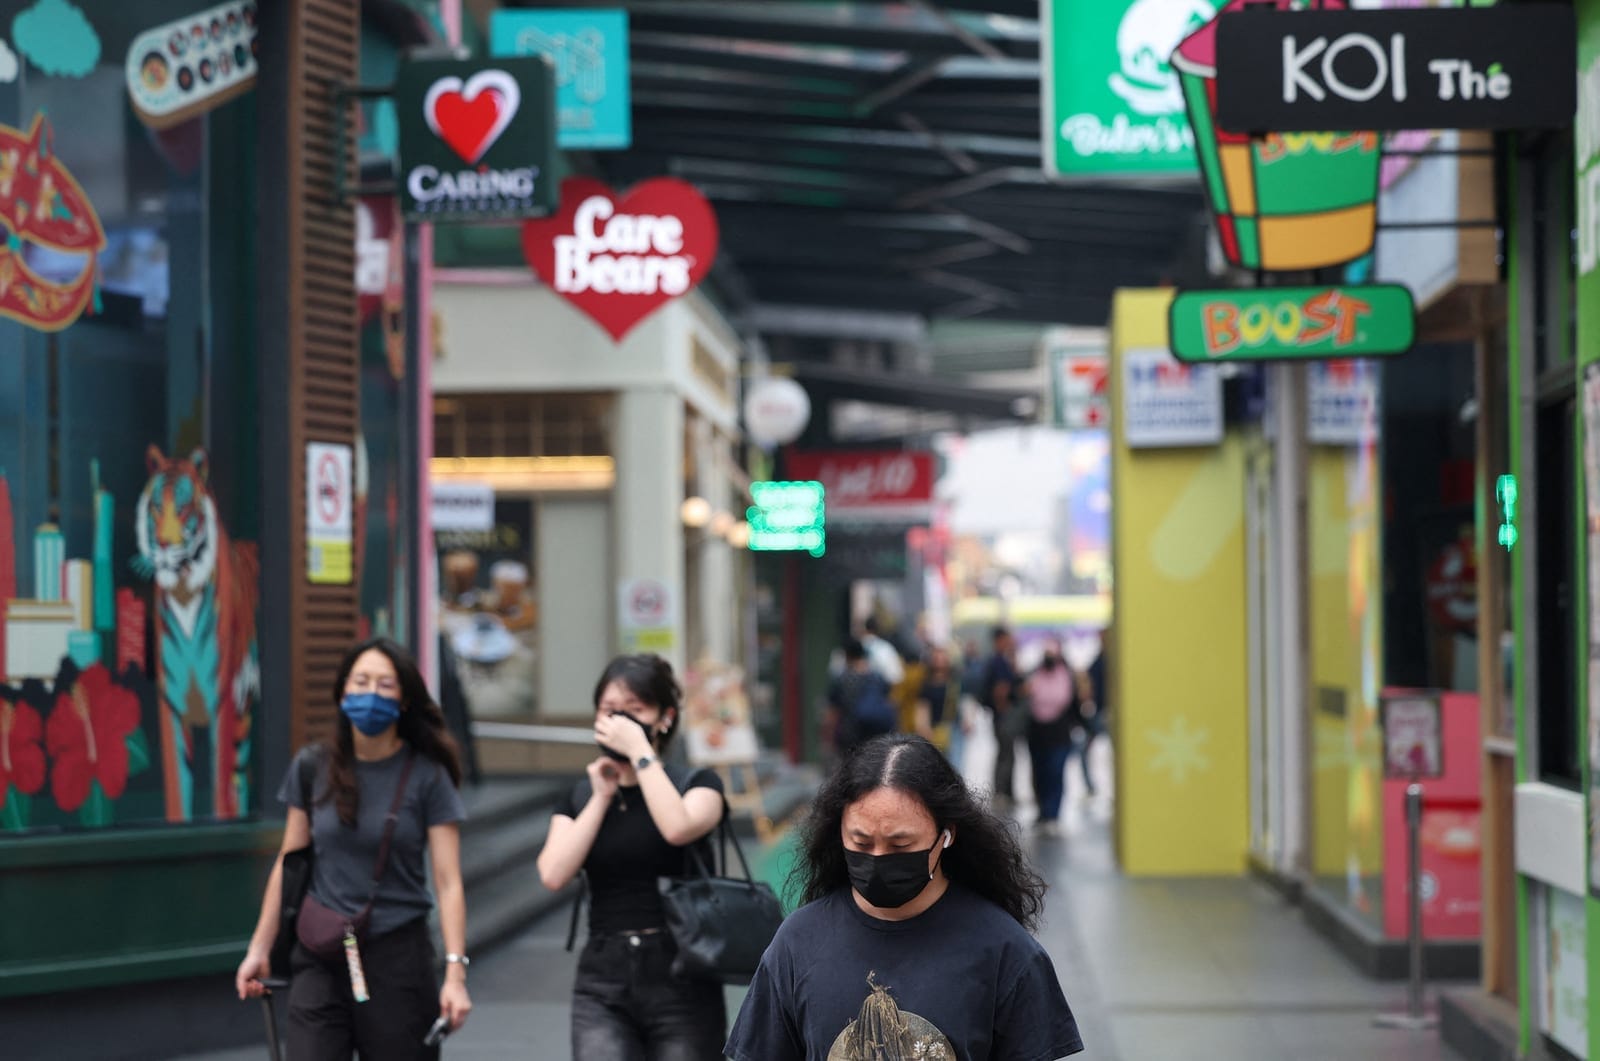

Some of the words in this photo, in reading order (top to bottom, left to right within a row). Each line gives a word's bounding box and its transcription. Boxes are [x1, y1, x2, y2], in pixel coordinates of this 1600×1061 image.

[1282, 32, 1407, 103] KOI
[573, 195, 683, 255] Care
[552, 234, 690, 296] Bears
[1202, 289, 1371, 358] BOOST
